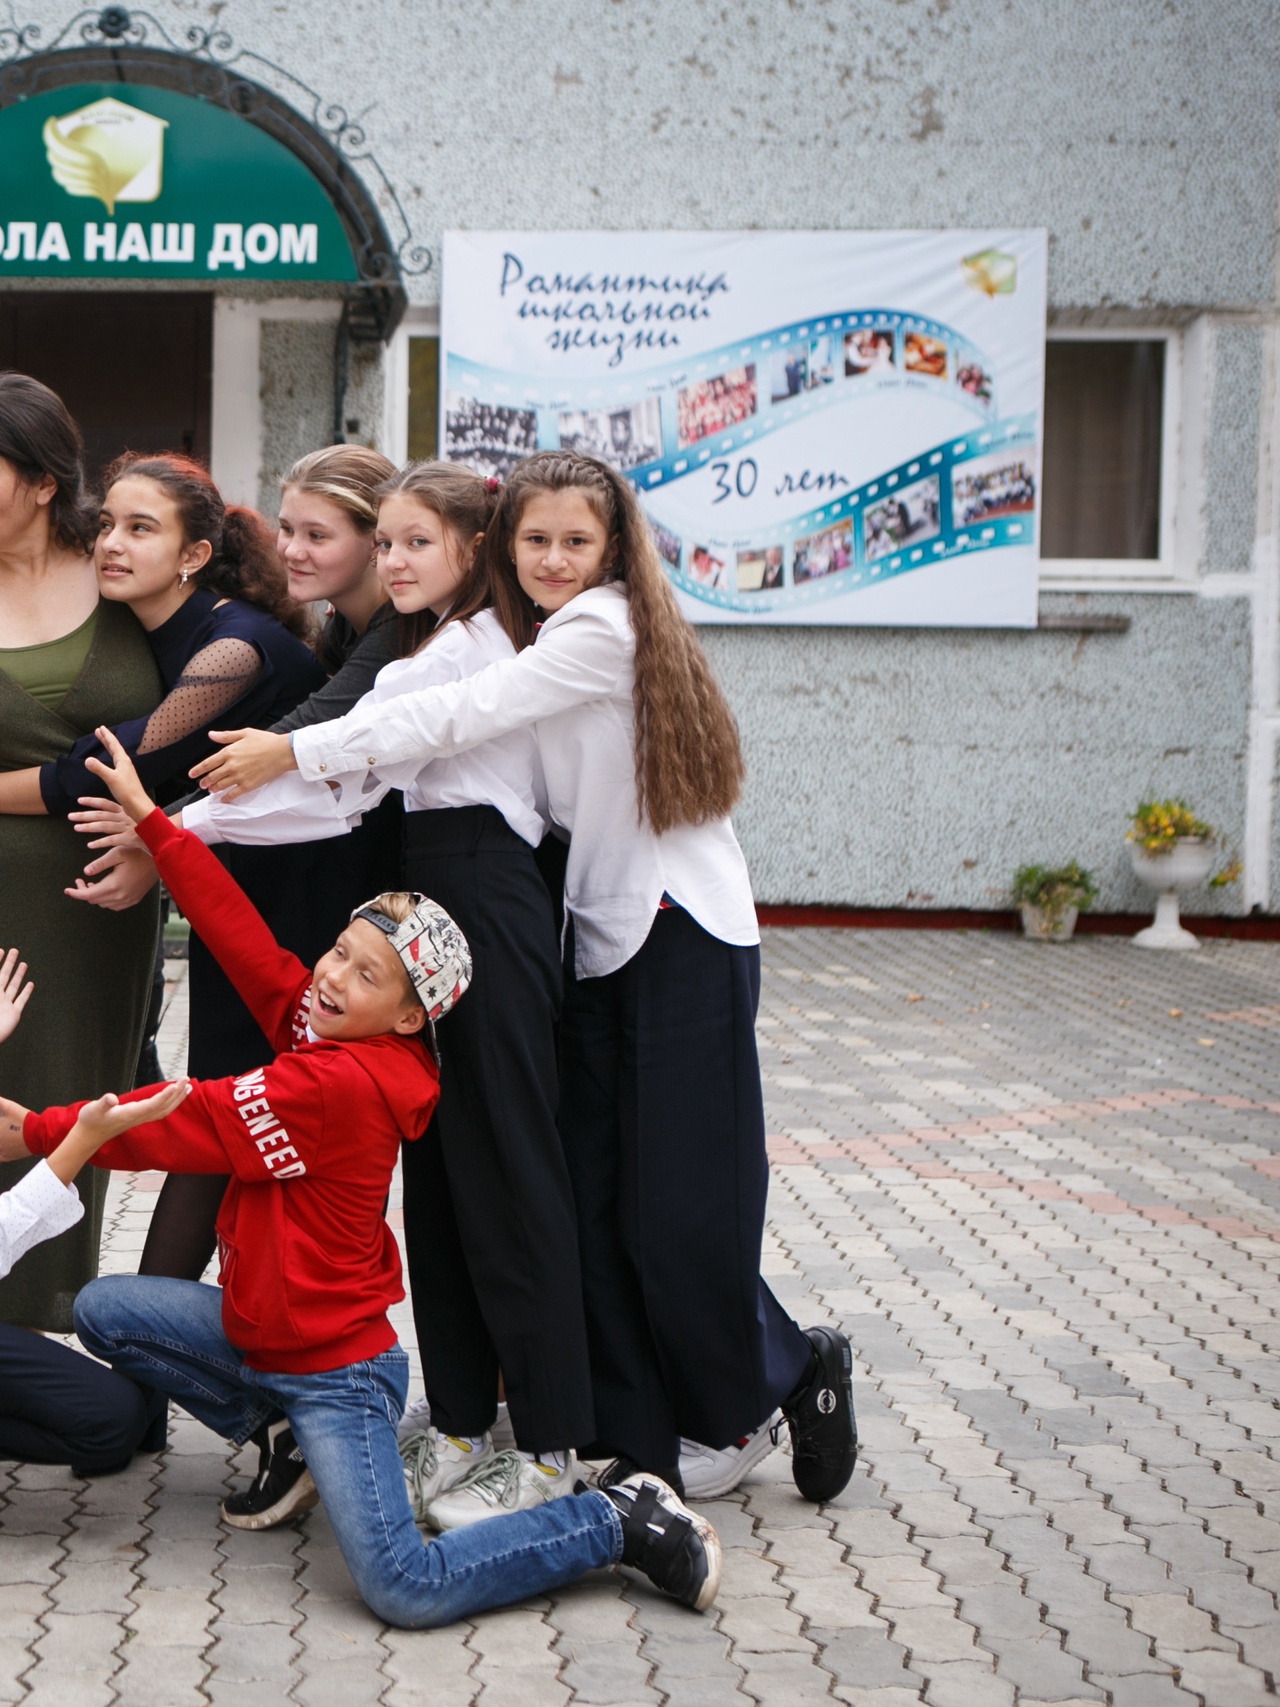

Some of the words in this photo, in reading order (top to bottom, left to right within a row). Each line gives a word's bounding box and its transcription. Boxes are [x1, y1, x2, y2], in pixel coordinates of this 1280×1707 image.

[83, 222, 195, 263] НАШ
[207, 223, 319, 271] ДОМ
[500, 252, 730, 297] Романтика
[517, 296, 711, 325] школьной
[546, 328, 680, 368] жизни
[711, 457, 759, 505] 30
[775, 469, 850, 496] лет
